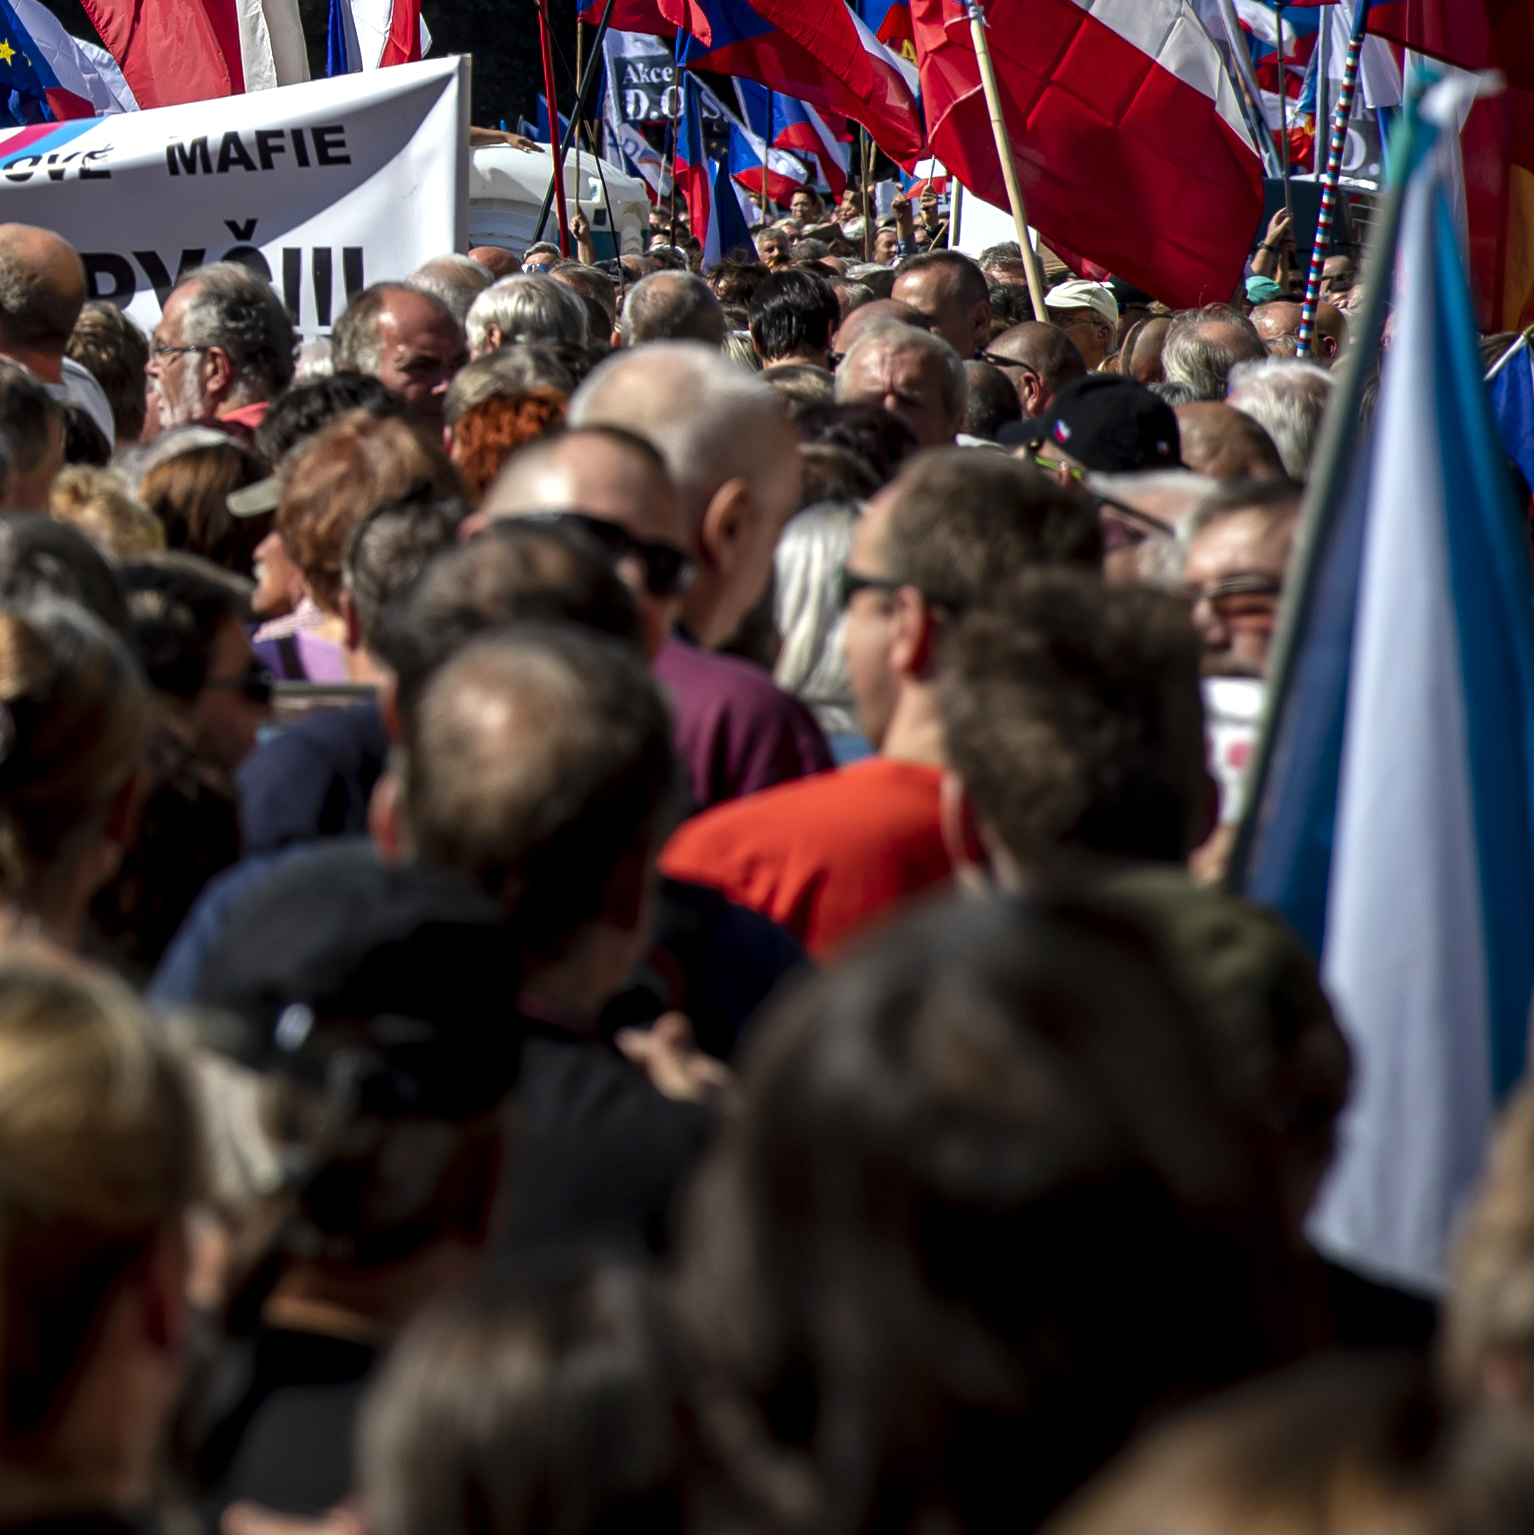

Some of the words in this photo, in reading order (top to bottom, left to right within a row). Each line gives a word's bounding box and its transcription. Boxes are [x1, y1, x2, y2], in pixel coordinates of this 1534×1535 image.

[623, 62, 674, 85] Akce
[164, 124, 353, 178] MAFIE
[79, 218, 365, 334] RYČ!!!
